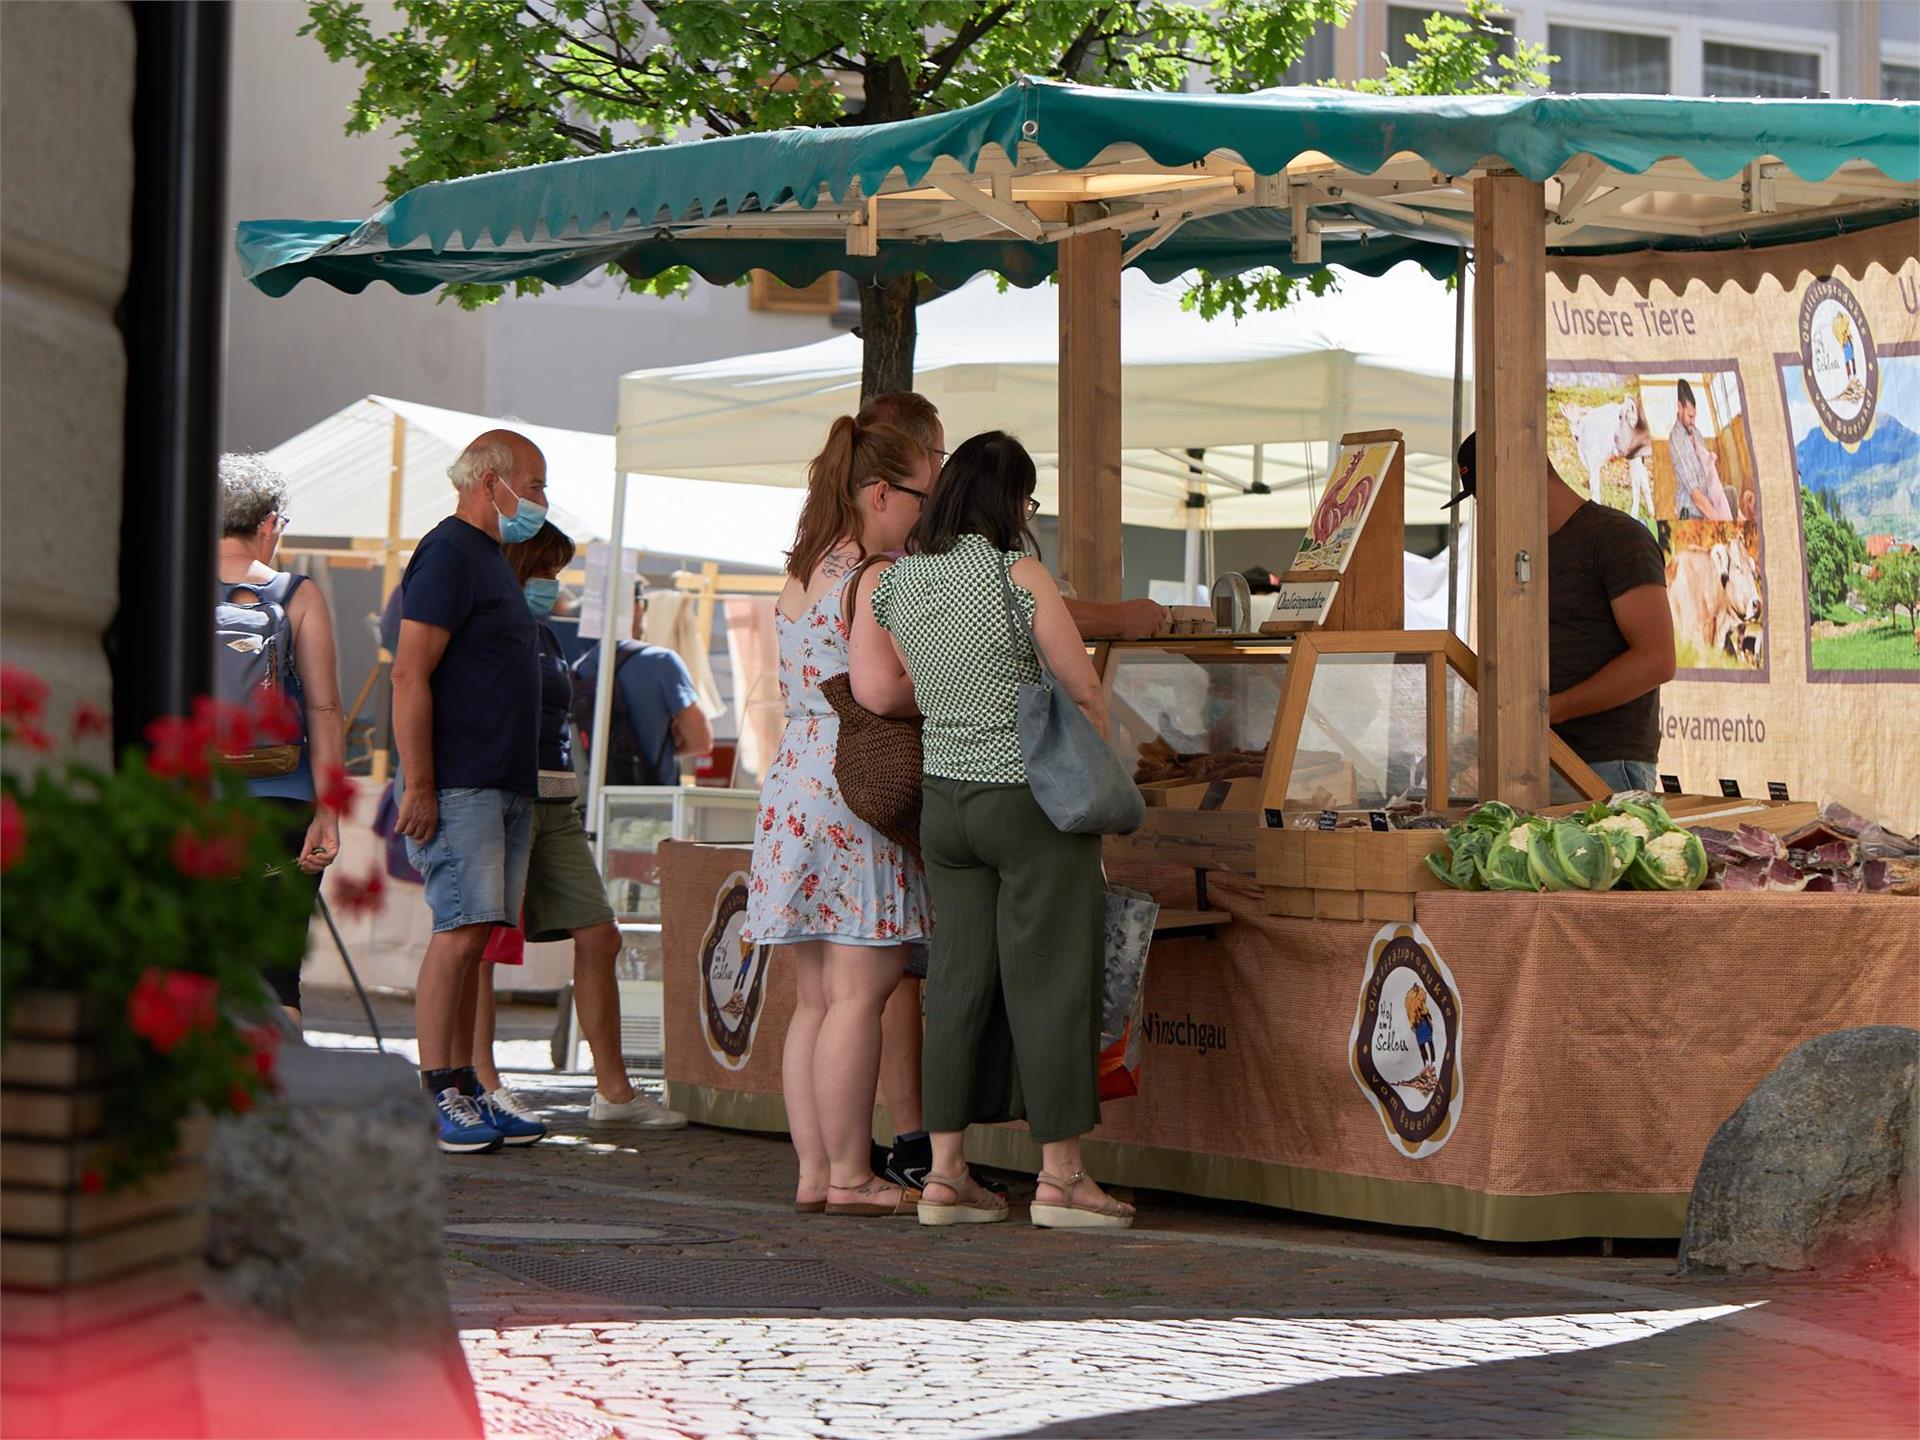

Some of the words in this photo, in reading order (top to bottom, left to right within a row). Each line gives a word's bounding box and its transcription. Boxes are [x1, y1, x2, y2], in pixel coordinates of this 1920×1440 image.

[1552, 300, 1633, 337] Unsere
[1634, 301, 1696, 337] Tiere
[1380, 1000, 1393, 1029] Hof
[1376, 1030, 1409, 1052] Schloss
[1371, 1074, 1399, 1111] vom
[1399, 1081, 1445, 1131] Bauernhof
